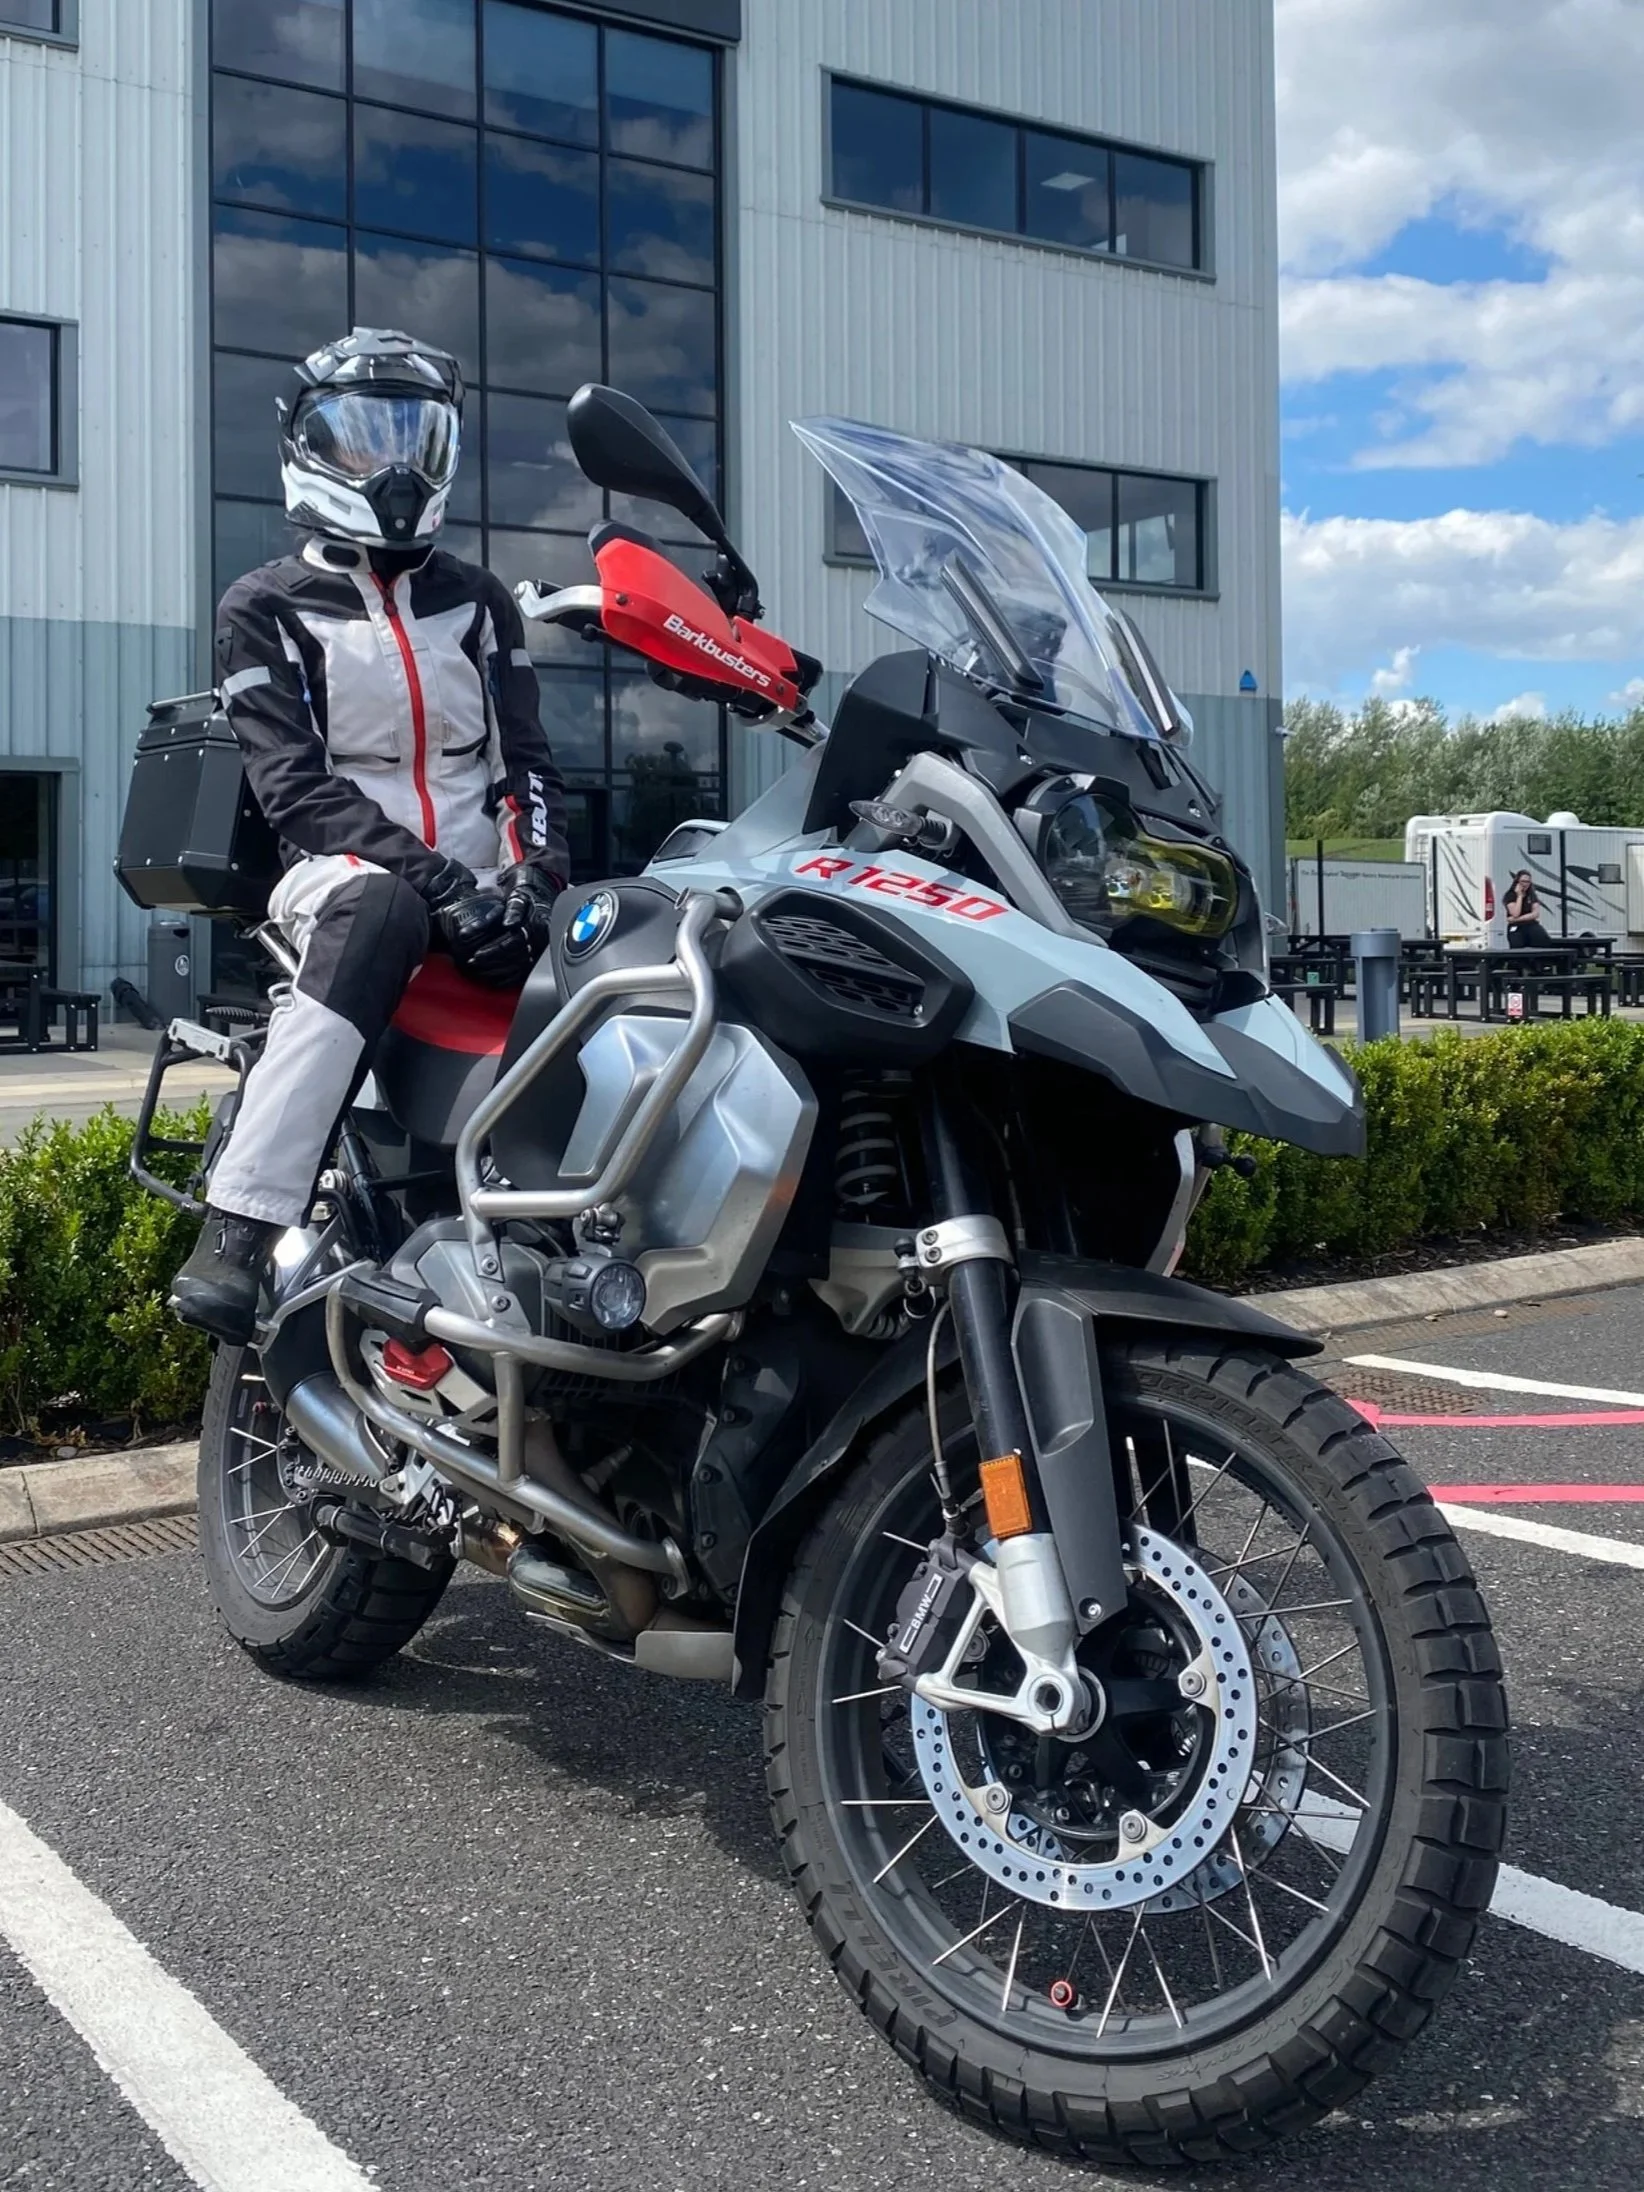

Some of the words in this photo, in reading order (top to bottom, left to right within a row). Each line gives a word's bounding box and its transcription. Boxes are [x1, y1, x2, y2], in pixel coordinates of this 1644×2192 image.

[663, 613, 771, 687] Barkbusters
[794, 856, 856, 880] R
[847, 865, 1009, 922] 1250
[1136, 1367, 1281, 1448] ORPION
[910, 1593, 933, 1630] BMW
[828, 1882, 958, 2028] PIRELLI
